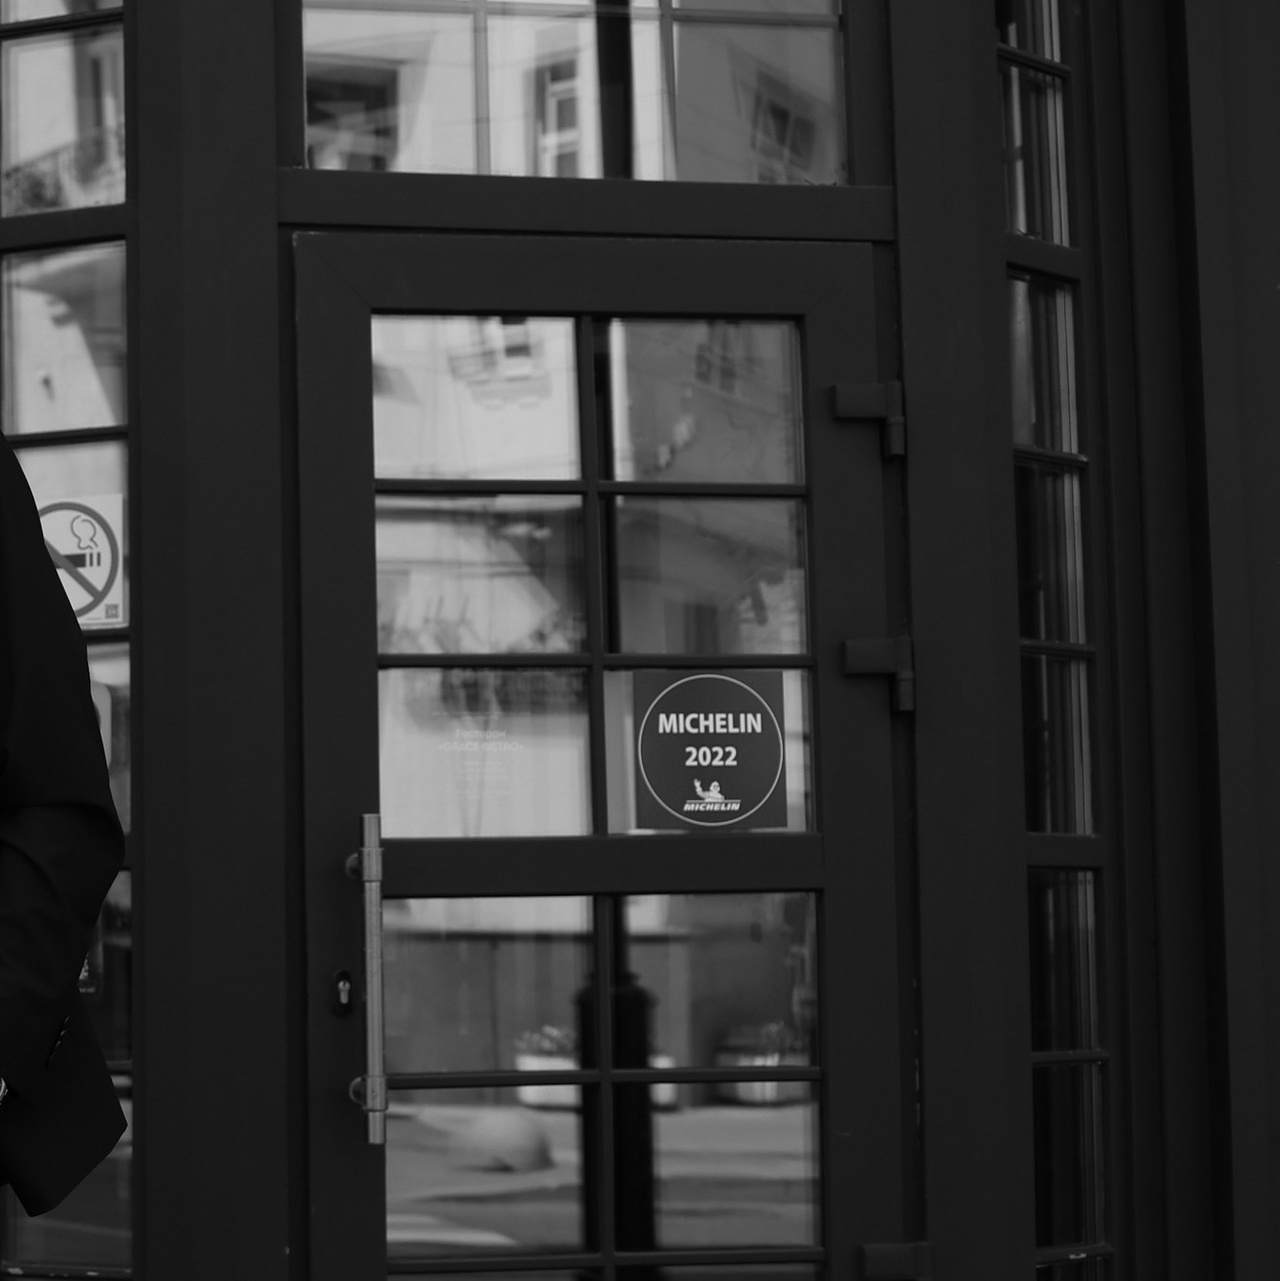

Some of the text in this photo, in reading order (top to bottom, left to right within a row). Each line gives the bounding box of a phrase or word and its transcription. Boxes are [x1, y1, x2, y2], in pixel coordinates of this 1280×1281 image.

[658, 712, 763, 734] MICHELIN
[685, 746, 738, 767] 2022
[683, 802, 741, 812] MICHELIN
